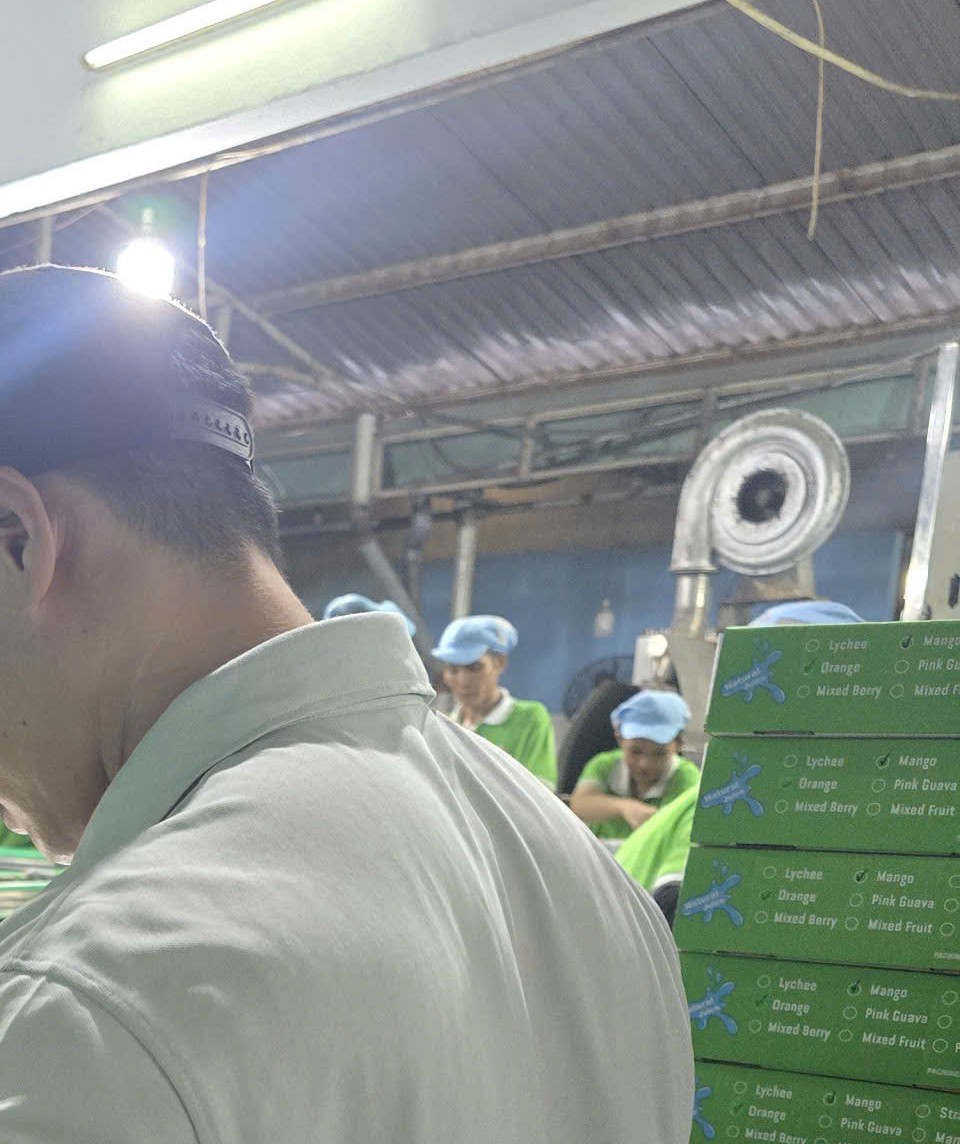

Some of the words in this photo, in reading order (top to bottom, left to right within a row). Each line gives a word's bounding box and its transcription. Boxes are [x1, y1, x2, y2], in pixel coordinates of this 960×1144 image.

[829, 639, 868, 654] Lychee
[821, 662, 861, 677] Orange
[918, 658, 943, 671] Pink
[816, 684, 849, 697] Mixed
[852, 685, 882, 699] Berry
[914, 683, 951, 697] Mixed
[806, 755, 845, 769] Lychee
[899, 755, 937, 770] Mango
[799, 777, 838, 793] Orange
[894, 778, 919, 791] Pink
[921, 778, 958, 791] Guava
[794, 801, 827, 813] Mixed
[829, 801, 859, 817] Berry
[890, 803, 925, 816] Mixed
[927, 804, 956, 817] Fruit
[785, 868, 823, 881] Lychee
[876, 870, 915, 887] Mango
[777, 889, 816, 903] Orange
[871, 894, 897, 907] Pink
[899, 895, 935, 909] Guava
[773, 911, 806, 925] Mixed
[808, 913, 838, 930] Berry
[868, 918, 902, 932] Mixed
[905, 921, 933, 934] Fruit
[778, 977, 817, 993] Lychee
[870, 984, 908, 1001] Mango
[772, 999, 810, 1015] Orange
[865, 1007, 890, 1020] Pink
[892, 1010, 928, 1024] Guava
[767, 1021, 800, 1036] Mixed
[802, 1024, 831, 1042] Berry
[862, 1031, 896, 1046] Mixed
[898, 1036, 927, 1050] Fruit
[755, 1084, 793, 1099] Lychee
[845, 1094, 882, 1112] Mango
[748, 1105, 787, 1122] Orange
[840, 1117, 865, 1131] Pink
[867, 1121, 902, 1136] Guava
[744, 1128, 777, 1143] Mixed
